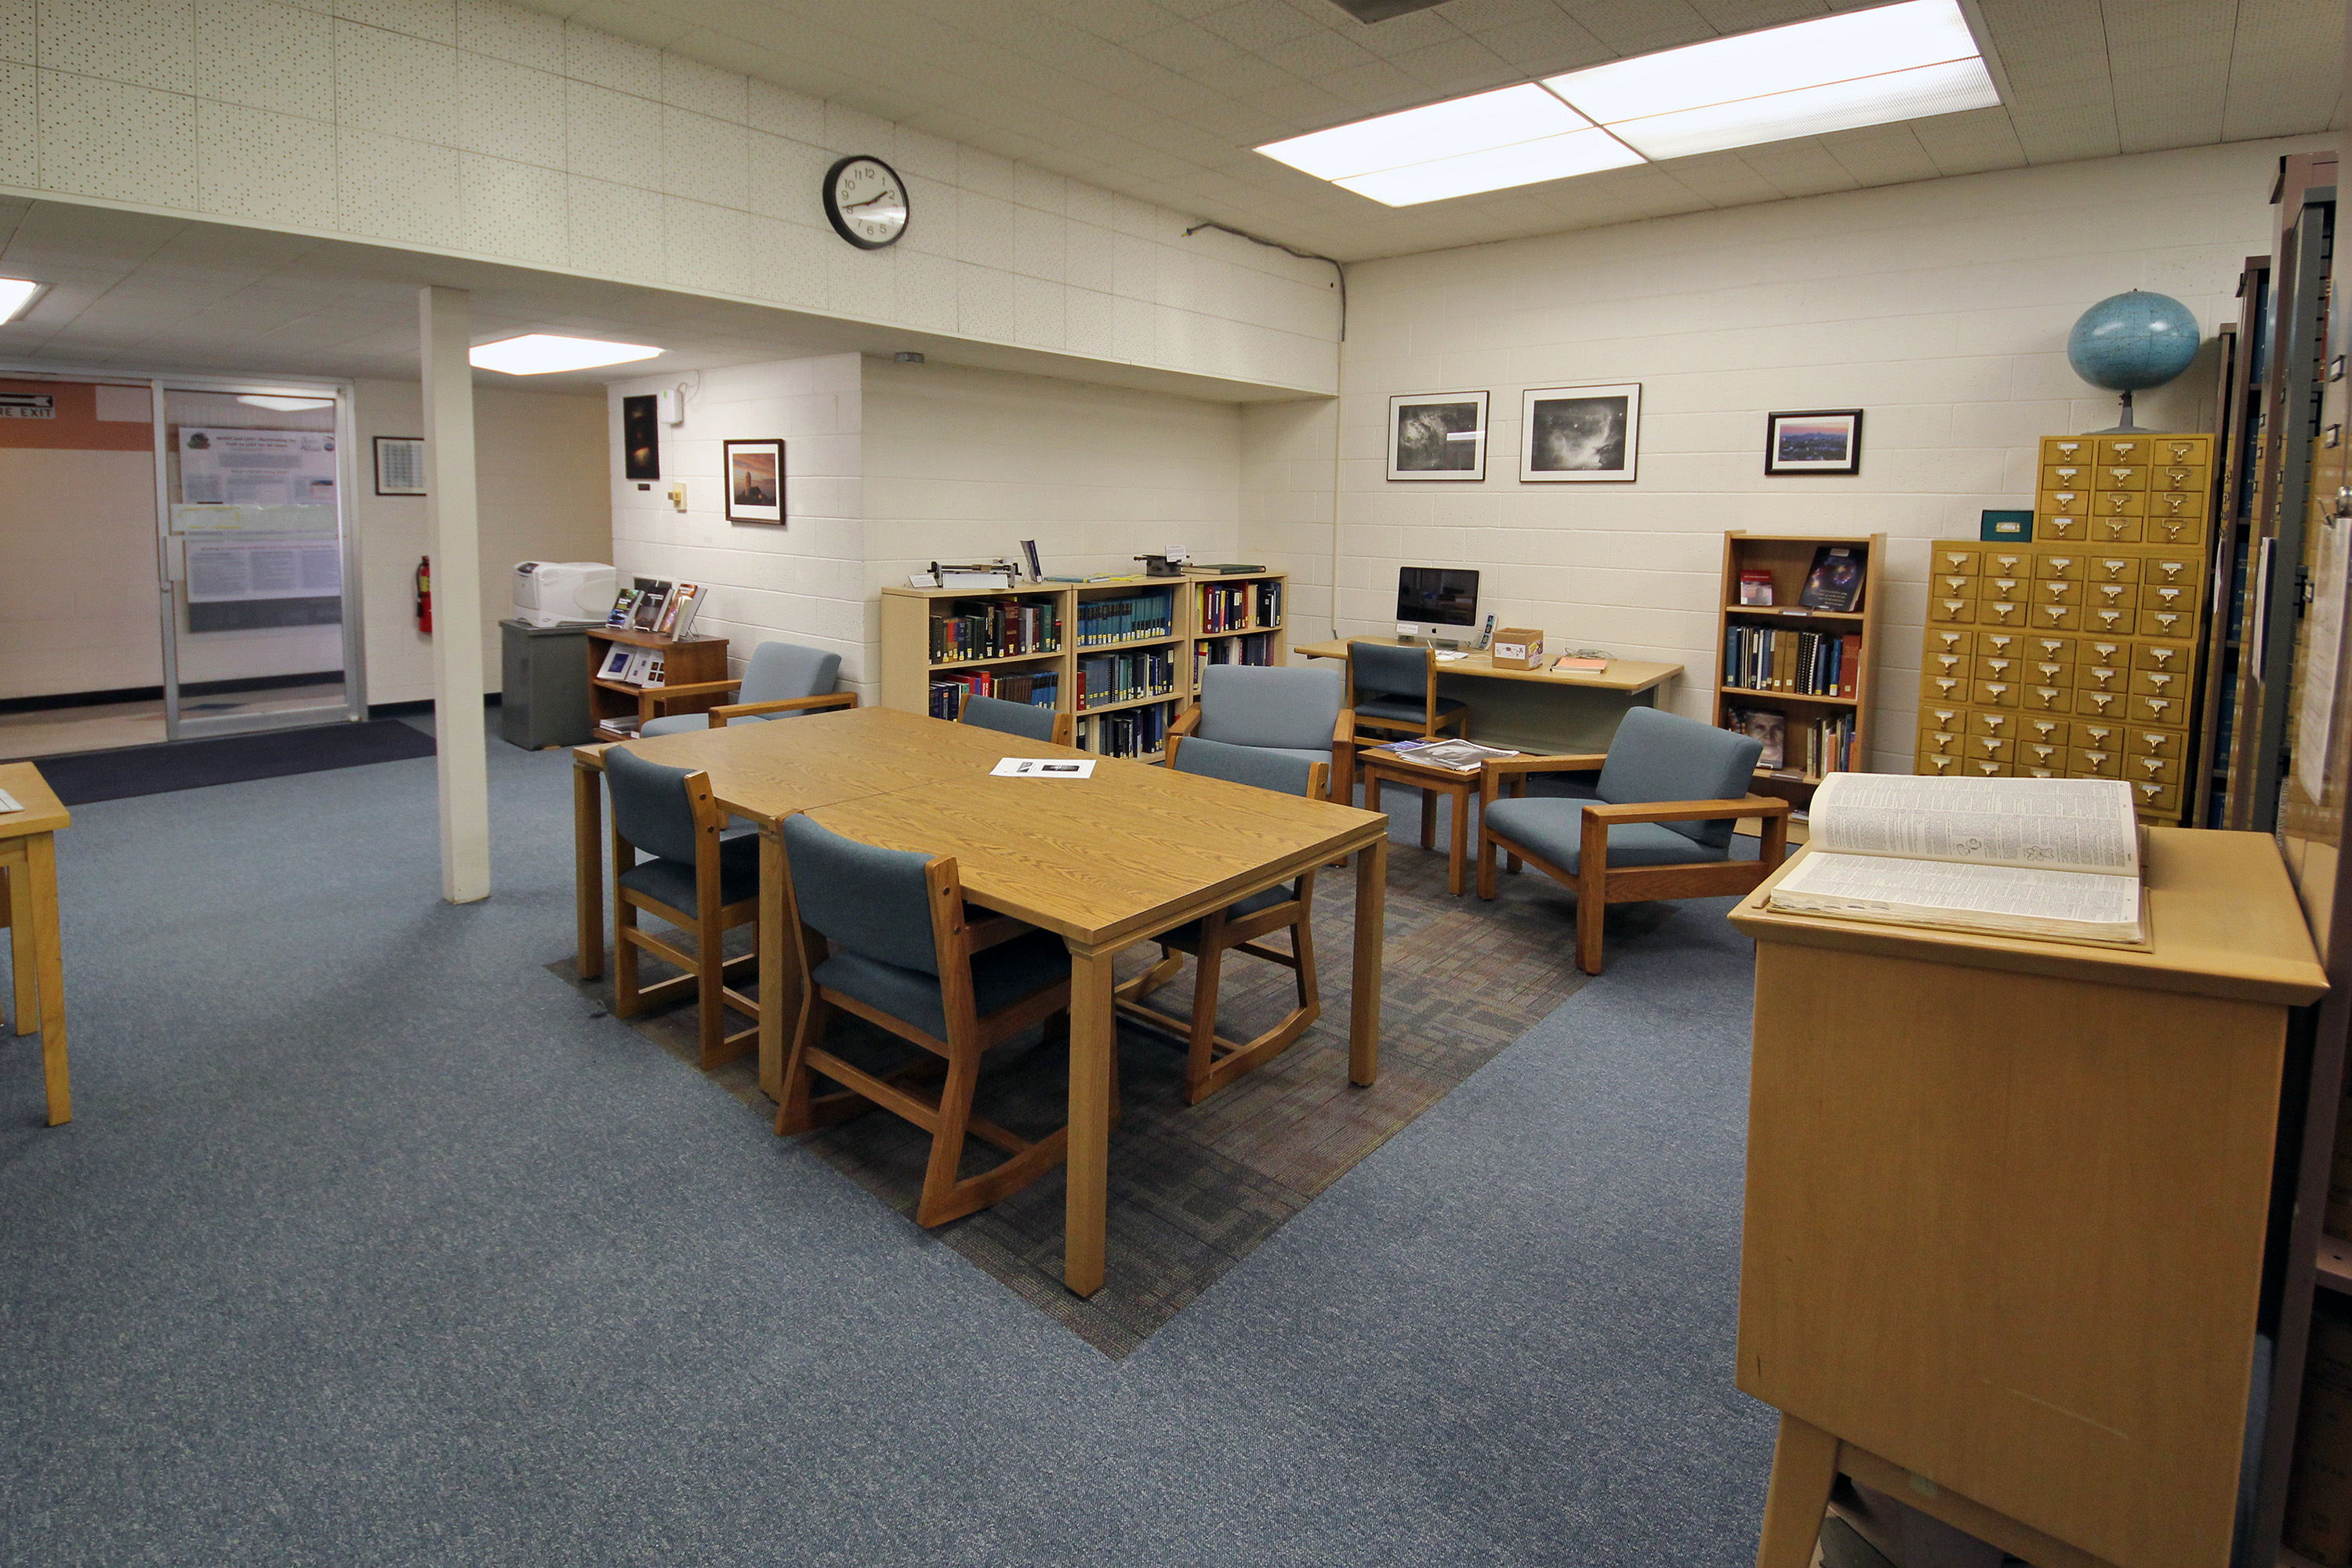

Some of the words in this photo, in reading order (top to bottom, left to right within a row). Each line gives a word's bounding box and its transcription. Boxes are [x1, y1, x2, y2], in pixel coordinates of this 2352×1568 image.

[855, 169, 862, 180] 11
[865, 168, 875, 180] 12
[844, 179, 855, 191] 10
[882, 176, 885, 187] 1
[841, 190, 849, 201] 9
[888, 190, 895, 200] 2
[846, 205, 853, 214] 8
[866, 225, 874, 235] 6
[880, 223, 887, 234] 5
[21, 408, 51, 417] EXIT
